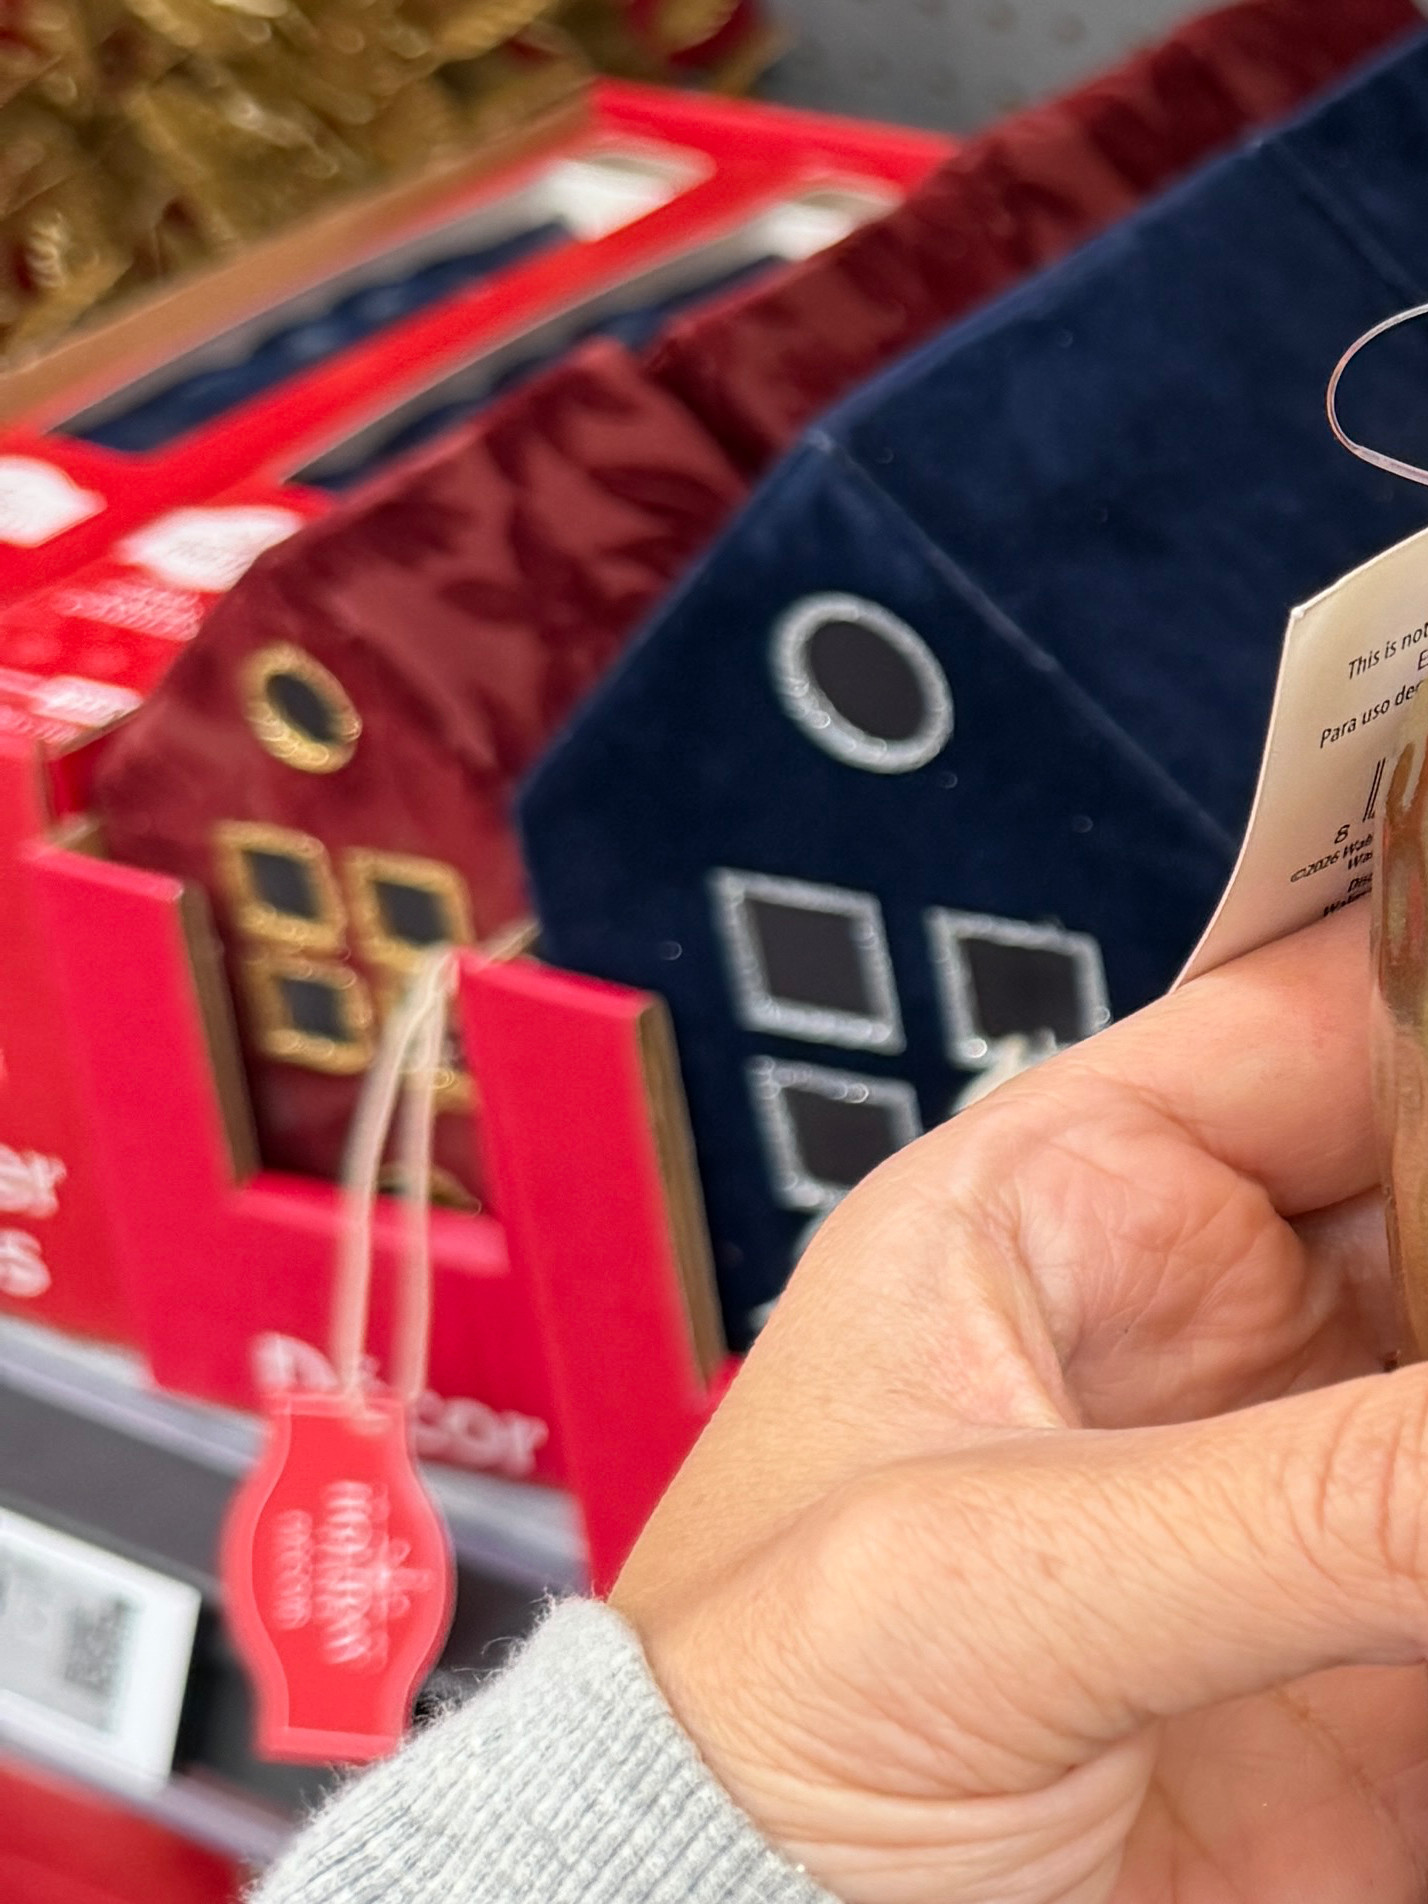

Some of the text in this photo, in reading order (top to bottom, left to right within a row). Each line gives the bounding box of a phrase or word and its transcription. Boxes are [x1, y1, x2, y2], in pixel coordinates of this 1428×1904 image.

[1348, 650, 1380, 680] This
[1384, 640, 1397, 660] is
[1401, 621, 1428, 650] not
[1320, 718, 1357, 749] Para
[1362, 699, 1390, 725] uso
